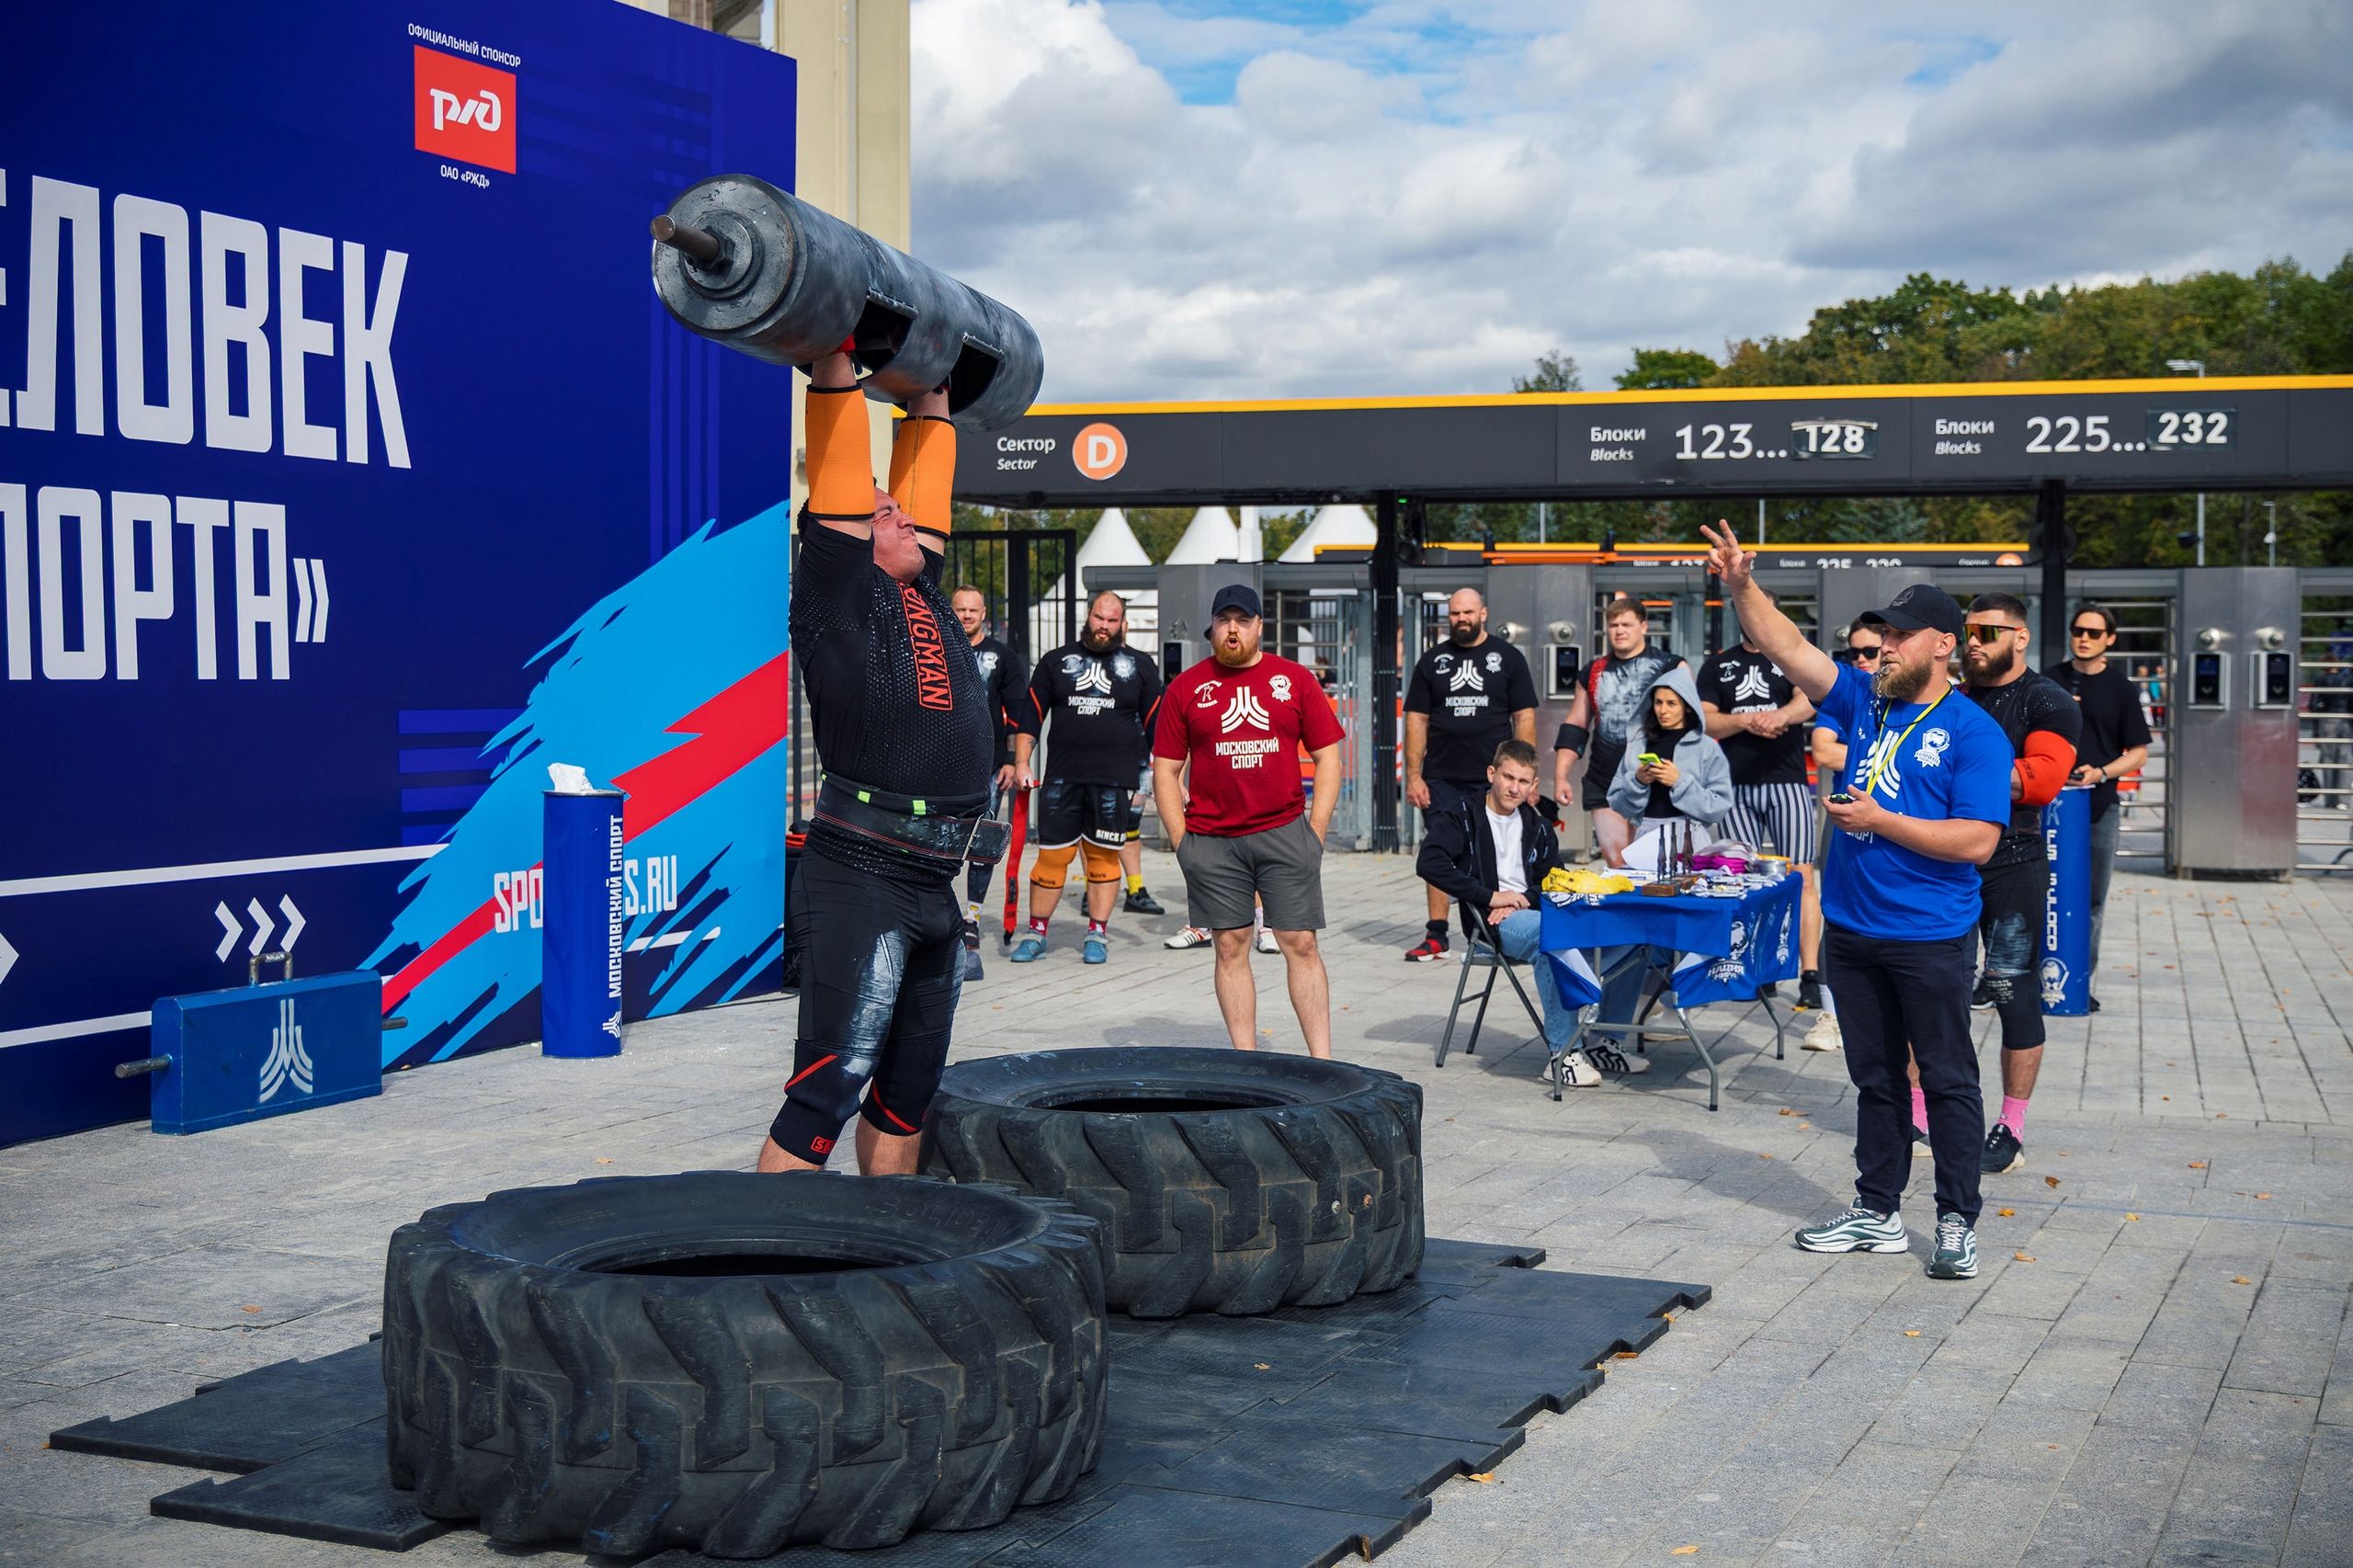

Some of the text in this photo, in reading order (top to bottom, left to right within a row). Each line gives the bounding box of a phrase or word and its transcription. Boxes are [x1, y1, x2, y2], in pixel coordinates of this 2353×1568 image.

[408, 23, 521, 68] ОФИЦИАЛЬНЫЙ СПОНСОР
[440, 165, 490, 189] ОАО «РЖД»
[0, 168, 411, 469] ЛОВЕК
[1590, 426, 1646, 442] Блоки
[1805, 425, 1865, 453] 128
[1935, 418, 1995, 435] Блоки
[2158, 412, 2228, 444] 232
[996, 435, 1117, 469] Сектор D
[1590, 448, 1634, 461] Blocks
[1935, 440, 1982, 455] Blocks
[996, 458, 1038, 471] Sector
[1068, 696, 1116, 710] МОСКОВСКИЙ
[1077, 706, 1101, 716] СПОРТ
[1215, 736, 1279, 756] МОСКОВСКИЙ
[1232, 754, 1264, 769] СПОРТ
[606, 814, 623, 999] МОСКОВСКИЙ СПОРТ
